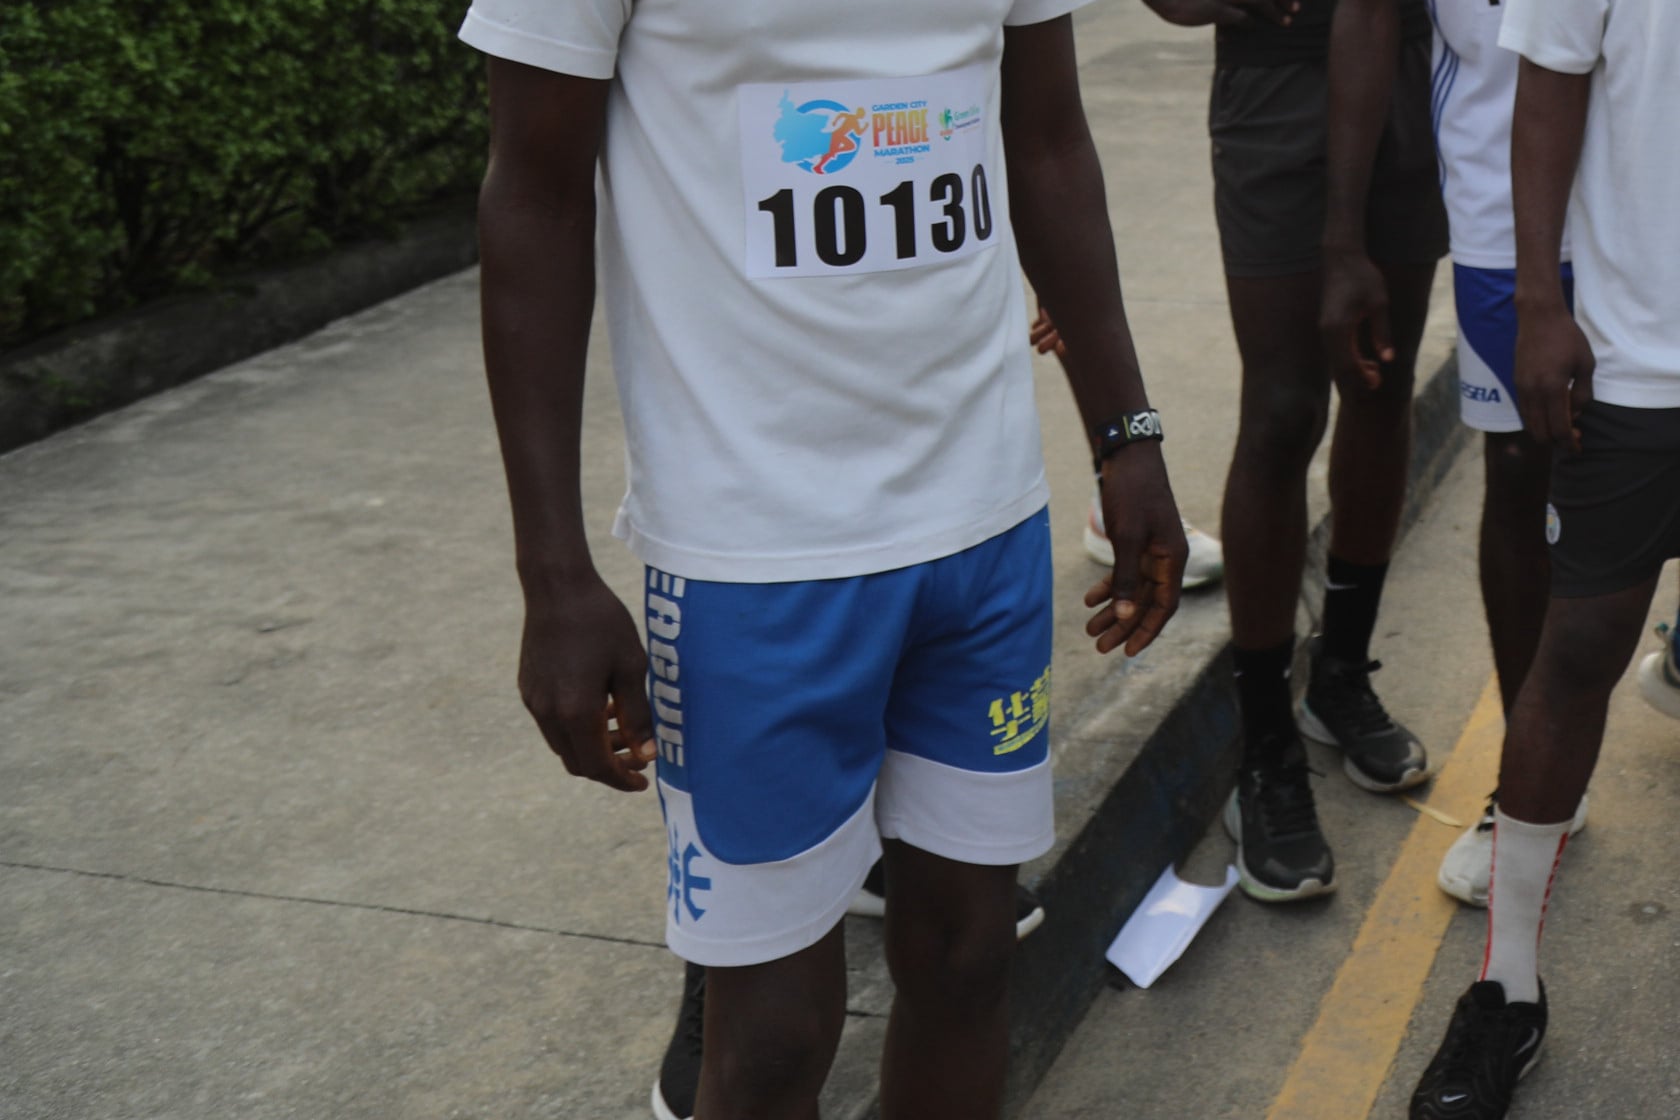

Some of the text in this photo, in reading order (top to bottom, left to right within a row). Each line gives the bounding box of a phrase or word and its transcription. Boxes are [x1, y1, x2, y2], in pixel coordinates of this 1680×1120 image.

[872, 100, 928, 112] GARDEN CITY
[872, 108, 930, 148] PEACE
[874, 144, 931, 157] MARATHON
[758, 163, 993, 268] 10130
